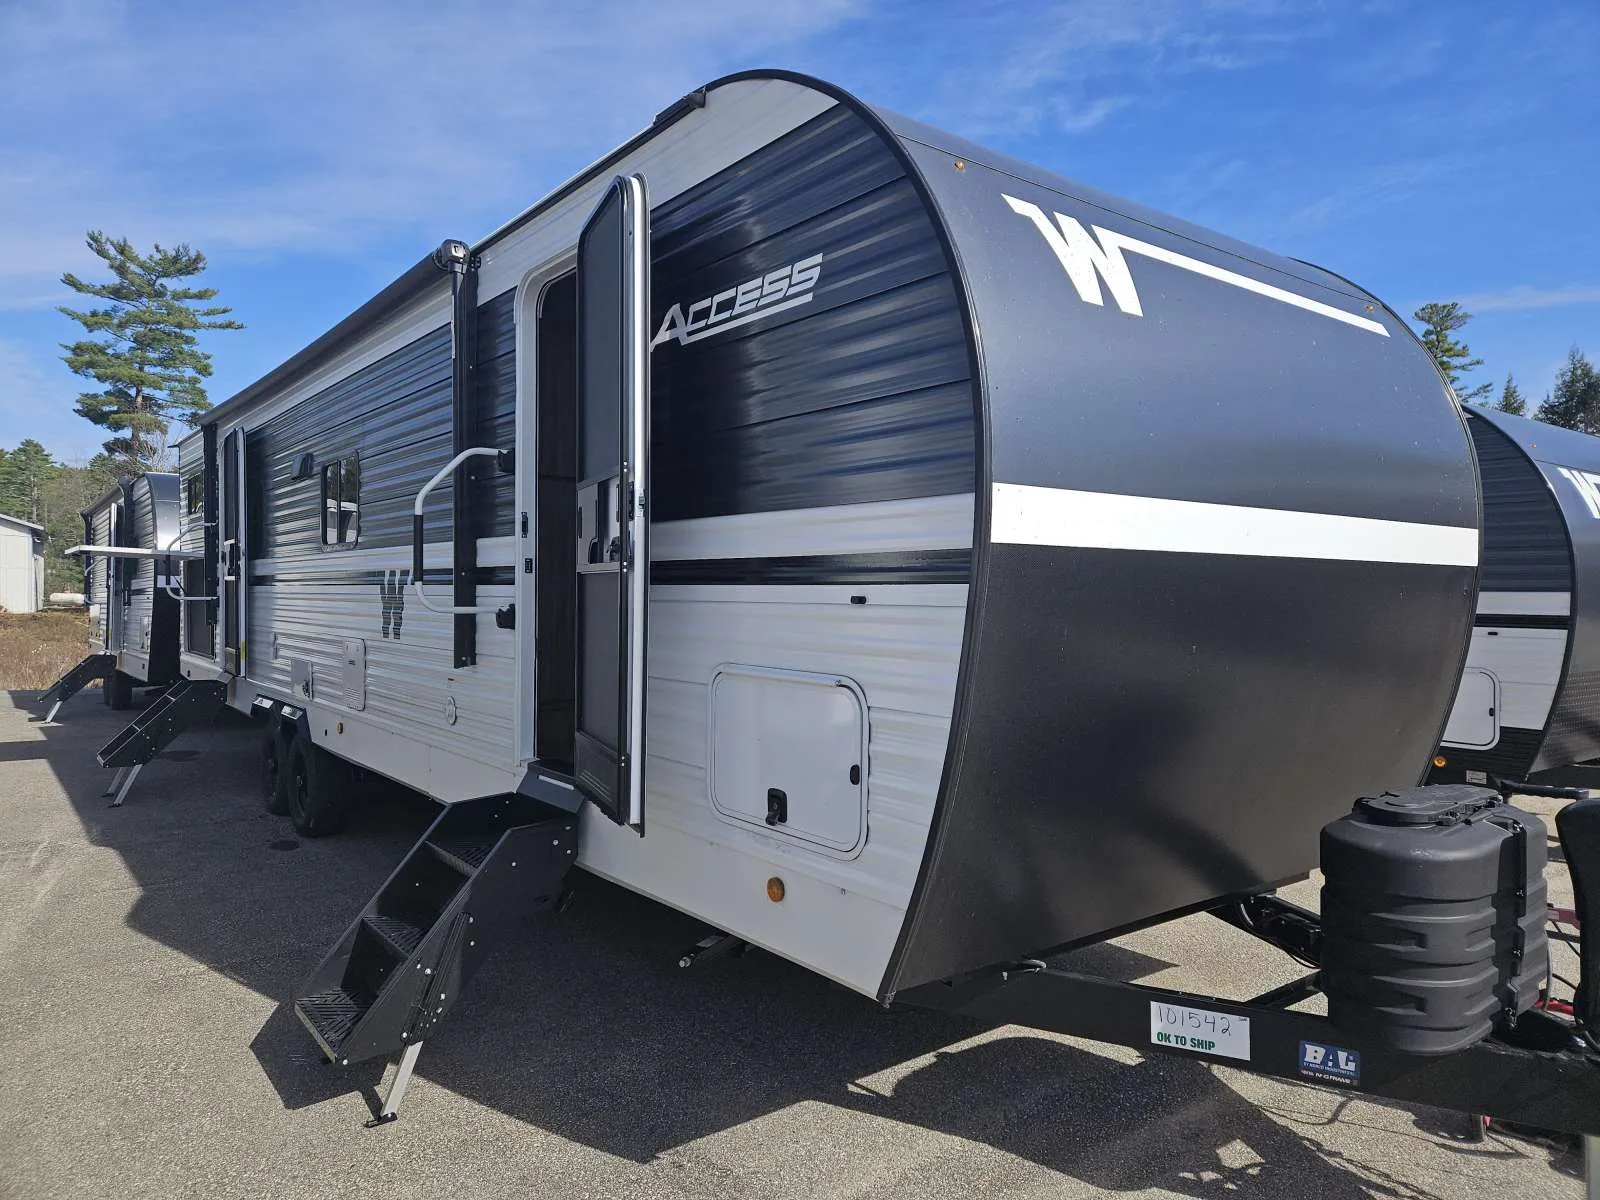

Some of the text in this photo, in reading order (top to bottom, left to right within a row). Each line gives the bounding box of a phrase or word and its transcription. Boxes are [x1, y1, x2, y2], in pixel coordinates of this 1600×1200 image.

[650, 253, 823, 352] ACCESS
[1159, 1005, 1232, 1037] 101542
[1156, 1031, 1216, 1051] OK TO SHIP
